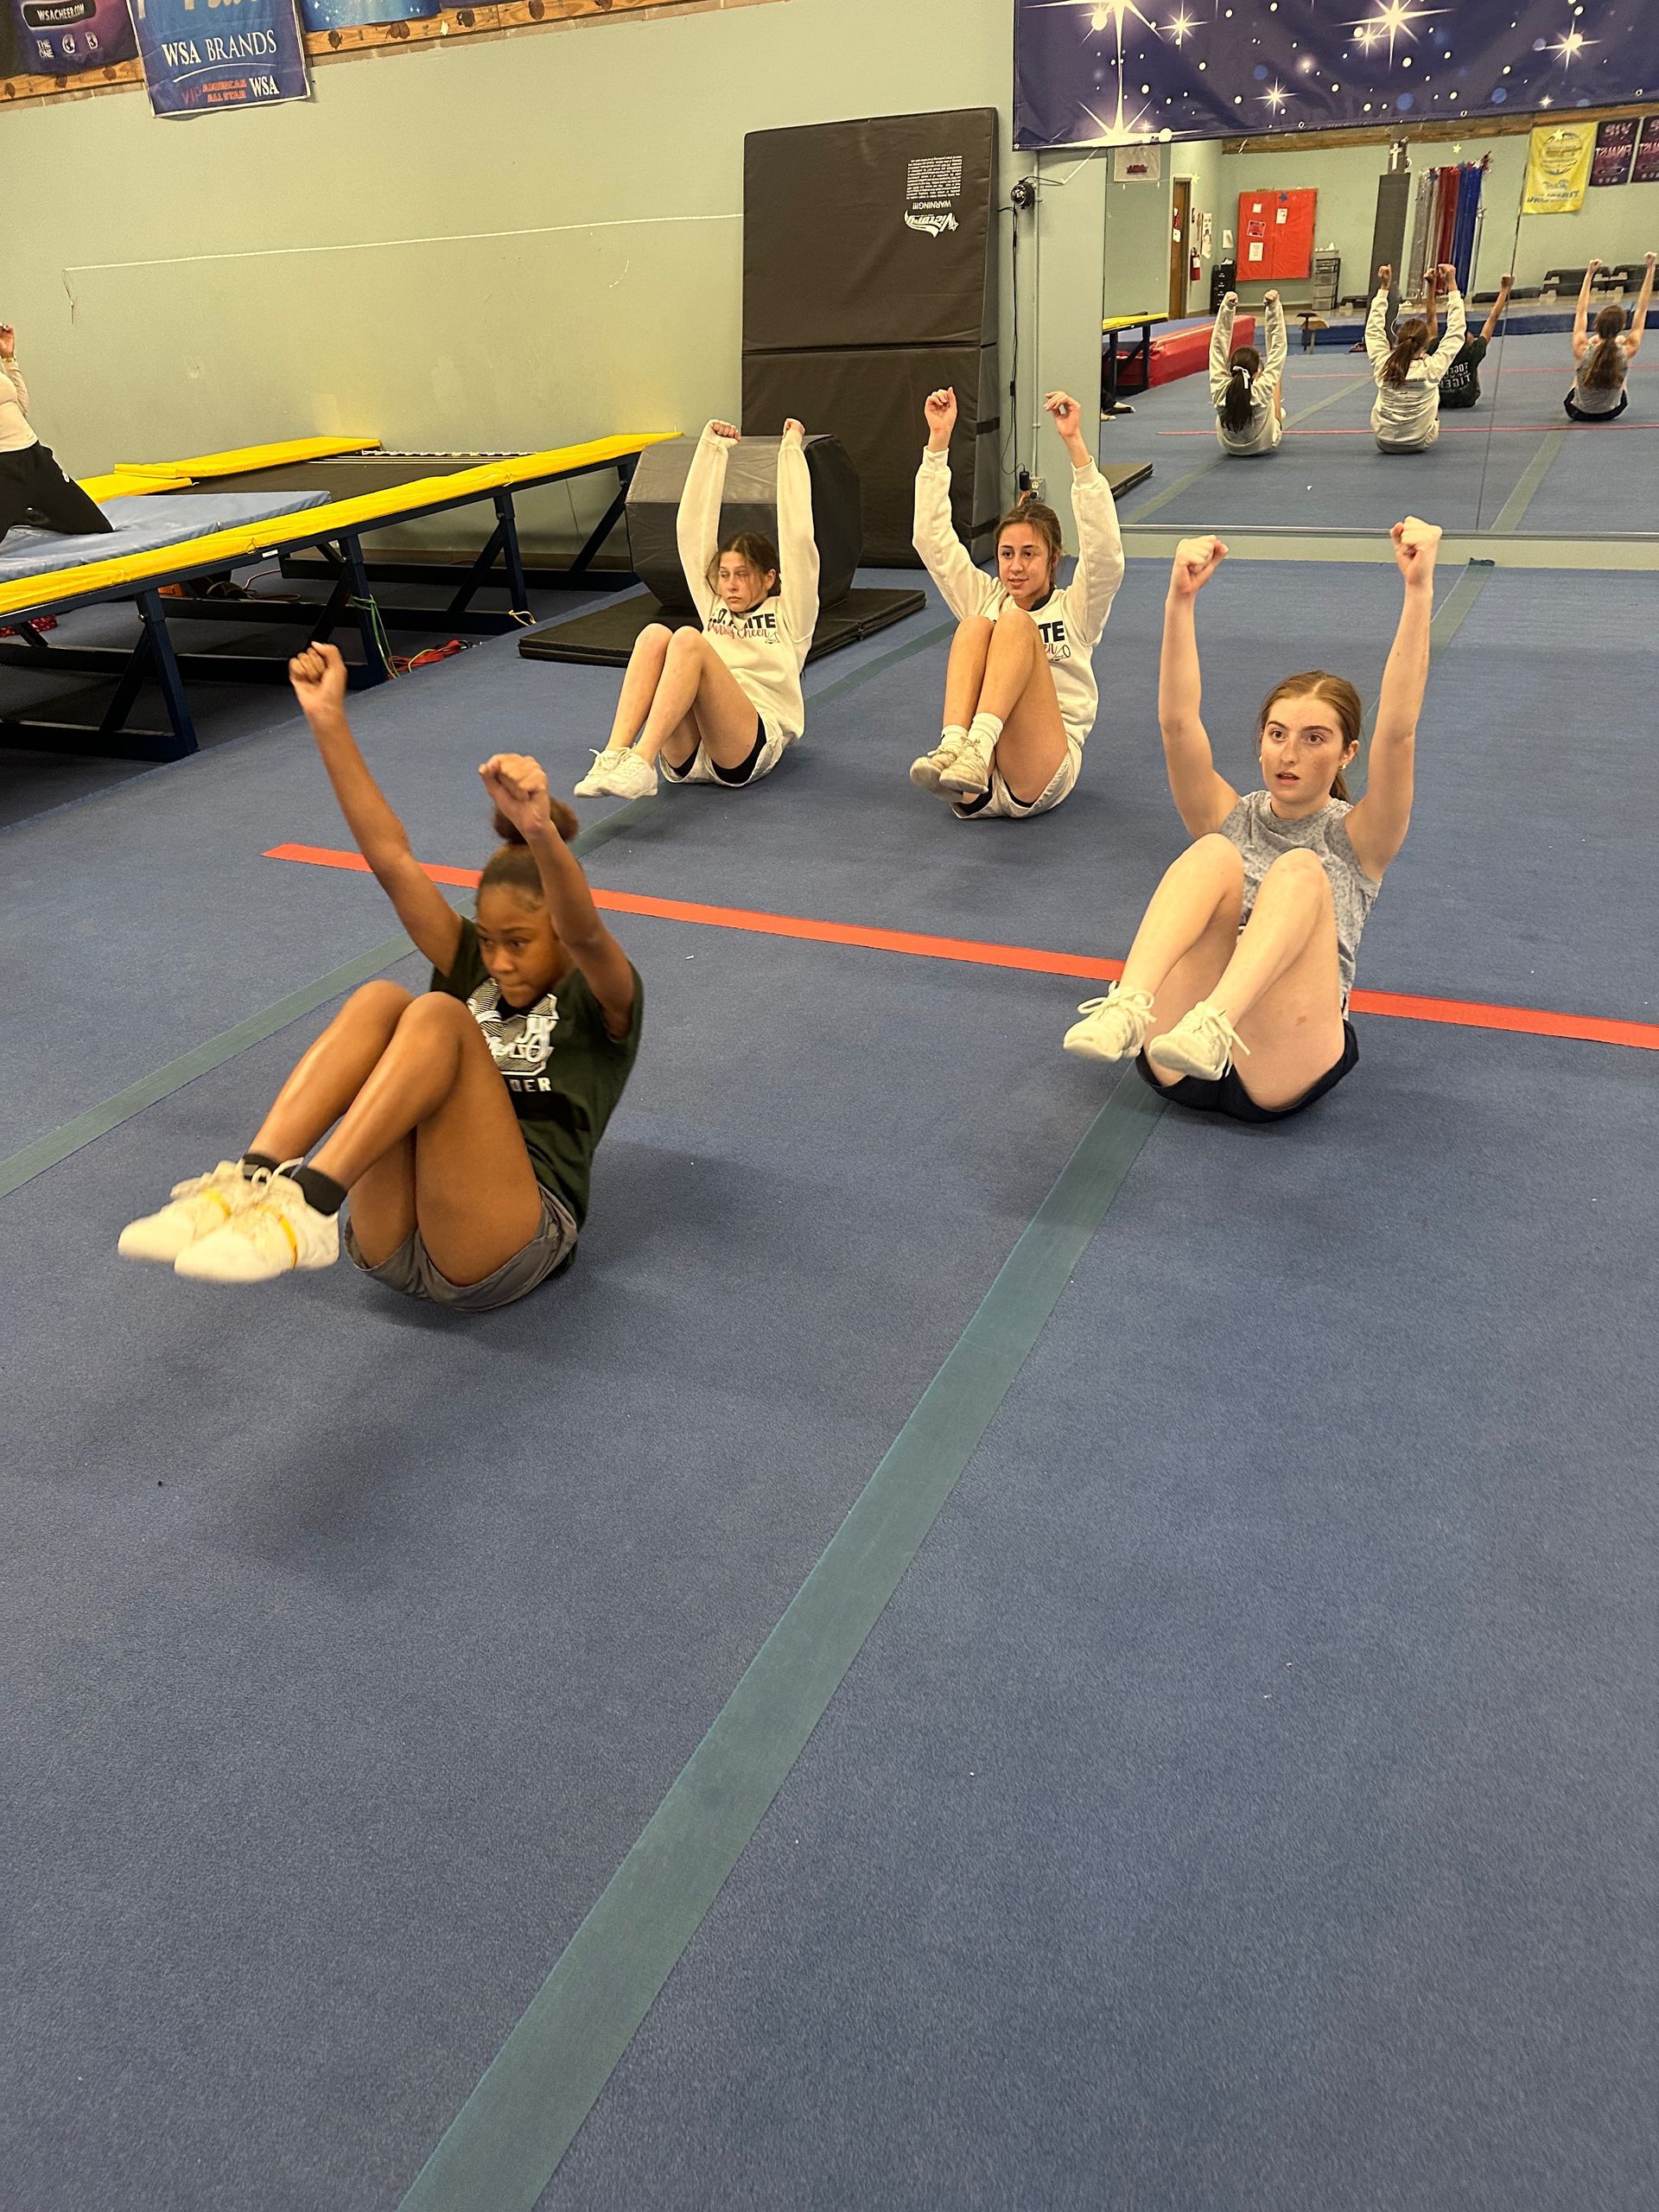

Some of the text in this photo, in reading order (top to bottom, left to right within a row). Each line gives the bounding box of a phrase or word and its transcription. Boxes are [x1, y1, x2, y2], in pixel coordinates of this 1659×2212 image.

[35, 3, 85, 21] WSACHEER.COM
[36, 39, 52, 50] THE
[162, 29, 277, 67] WSA BRANDS
[39, 49, 54, 59] ONE
[181, 86, 203, 105] VIP
[249, 75, 280, 98] WSA
